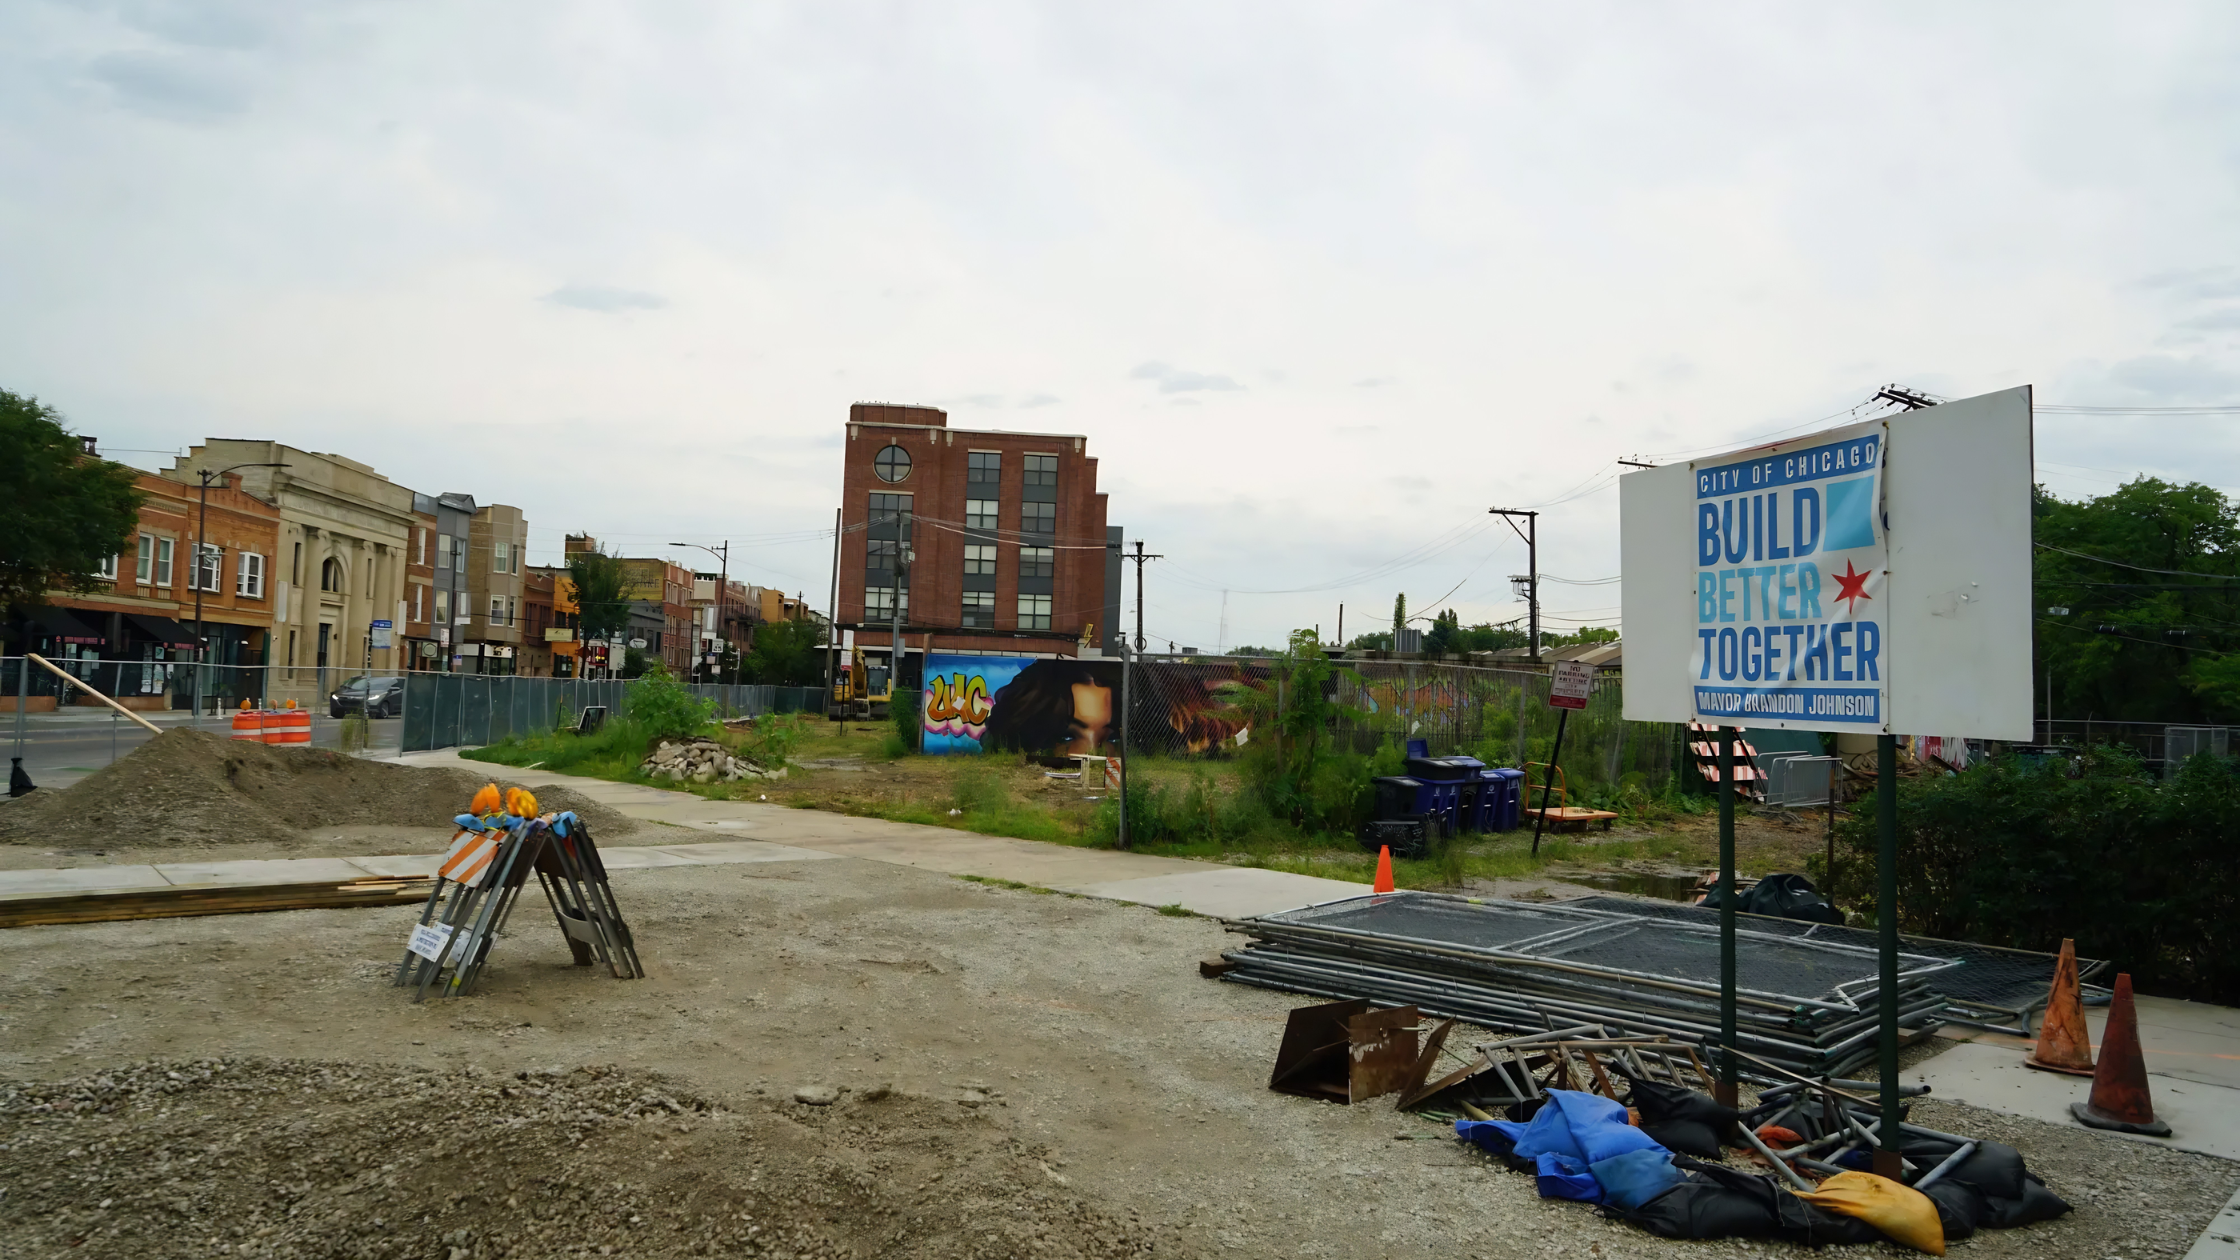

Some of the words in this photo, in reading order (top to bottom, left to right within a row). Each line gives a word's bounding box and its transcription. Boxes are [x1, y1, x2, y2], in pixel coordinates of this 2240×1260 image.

[1700, 468, 1740, 493] CITY
[1752, 462, 1773, 485] OF
[1785, 441, 1876, 479] CHICAGO
[1698, 486, 1820, 567] BUILD
[1698, 561, 1823, 624] BETTER
[1698, 620, 1881, 682] TOGETHER
[1698, 691, 1741, 712] MAYOR
[1744, 693, 1804, 714] BRANDON
[1808, 694, 1875, 717] JOHNSON
